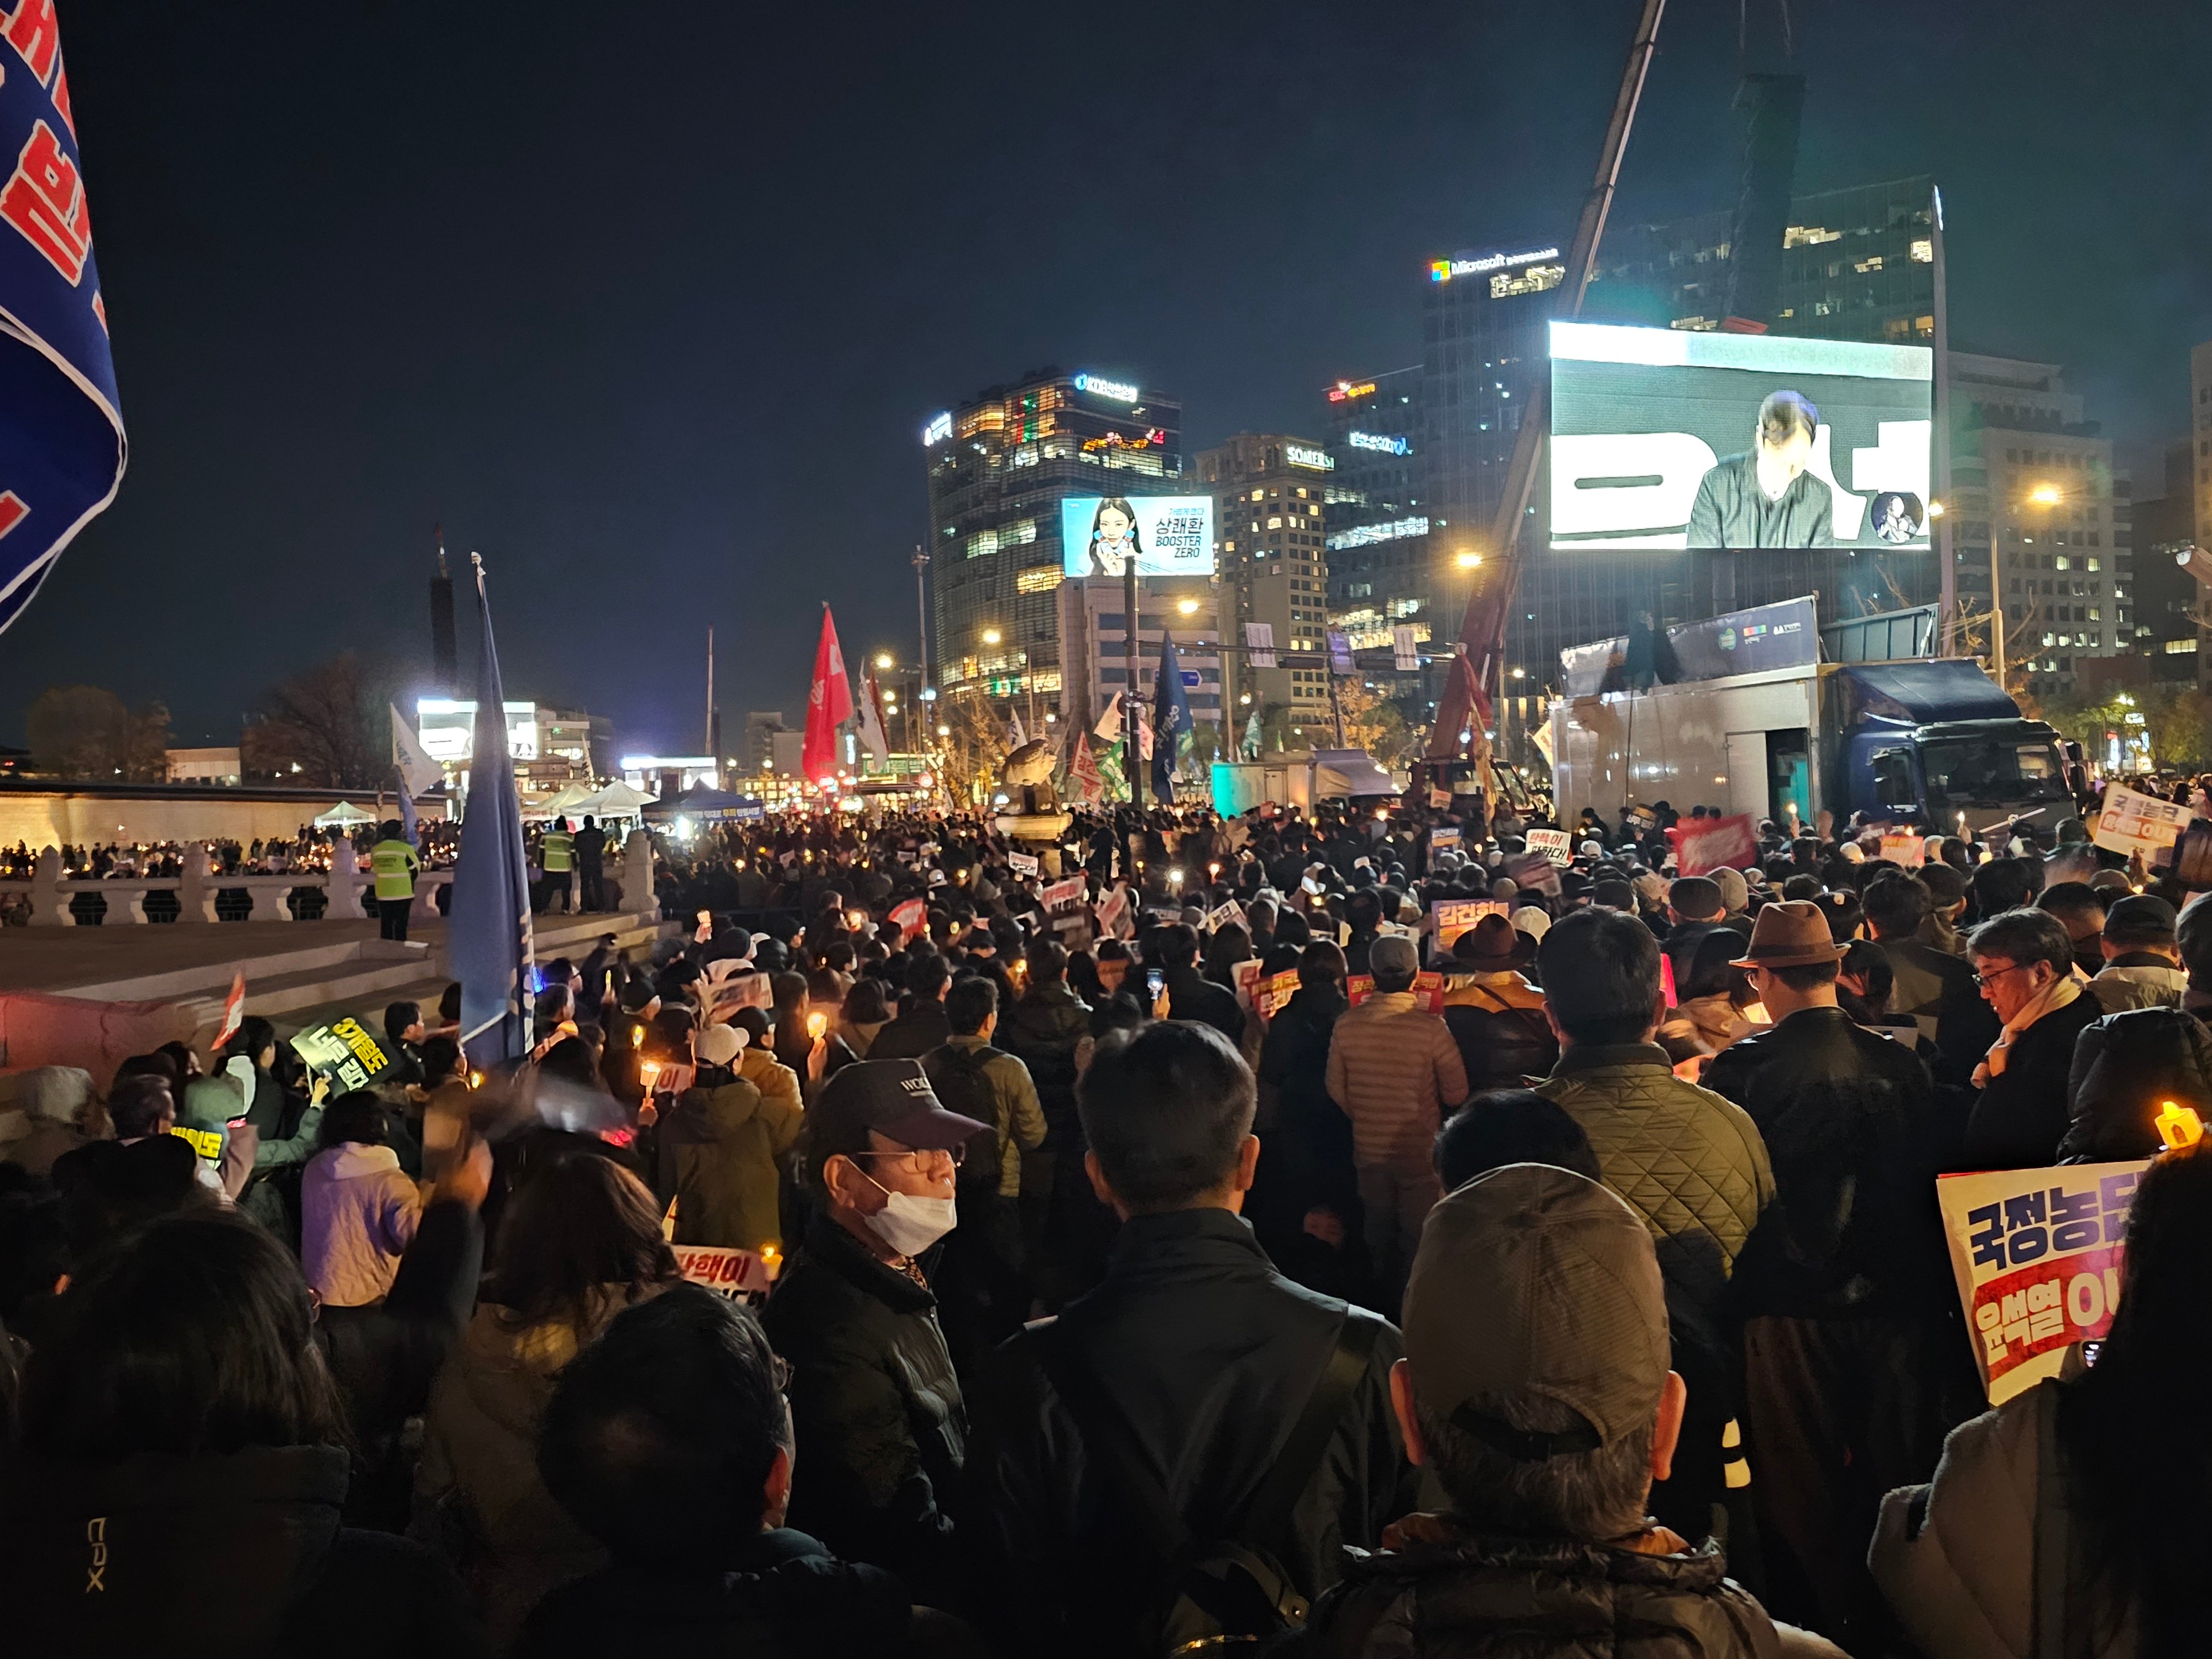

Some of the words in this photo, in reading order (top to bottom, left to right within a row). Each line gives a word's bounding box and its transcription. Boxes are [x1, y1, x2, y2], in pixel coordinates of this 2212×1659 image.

[1451, 253, 1505, 274] Microsoft
[1156, 518, 1203, 534] 상쾌환
[1156, 535, 1201, 547] BOOSTER
[1174, 547, 1200, 558] ZERO
[1528, 833, 1563, 846] 탄핵이
[2141, 823, 2178, 847] OUT
[333, 1018, 388, 1074] 3개월도
[309, 1026, 349, 1064] 너무
[337, 1057, 369, 1091] 길다
[1976, 1279, 2064, 1366] 윤석열
